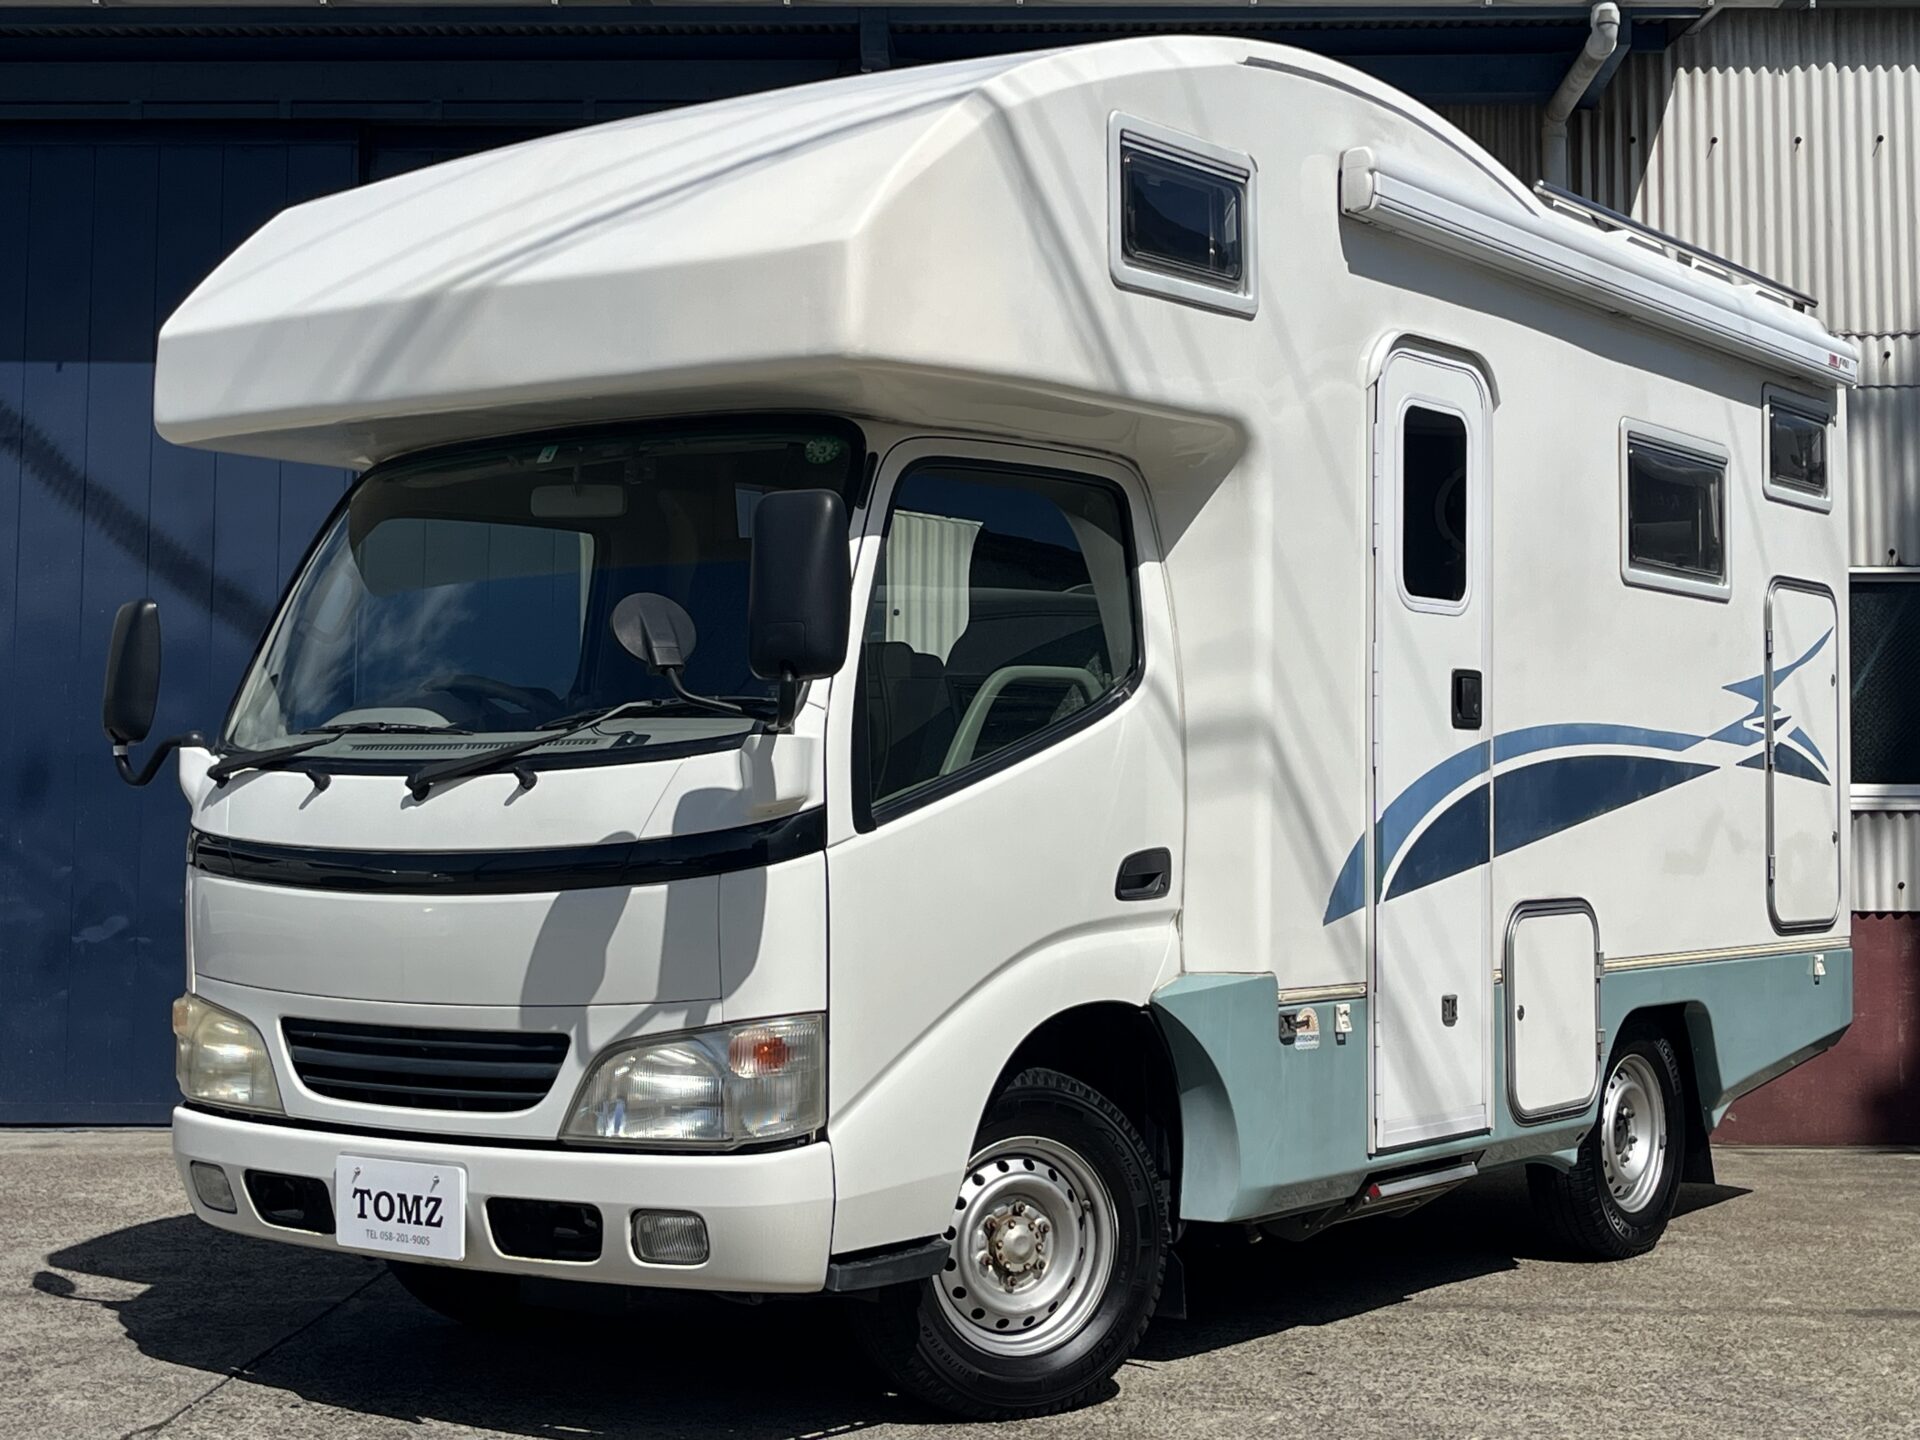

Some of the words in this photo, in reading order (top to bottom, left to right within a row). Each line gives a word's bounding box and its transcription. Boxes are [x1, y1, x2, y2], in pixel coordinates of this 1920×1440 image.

[352, 1187, 444, 1228] TOMZ
[366, 1229, 378, 1239] TEL
[380, 1232, 430, 1246] 058-201-9005
